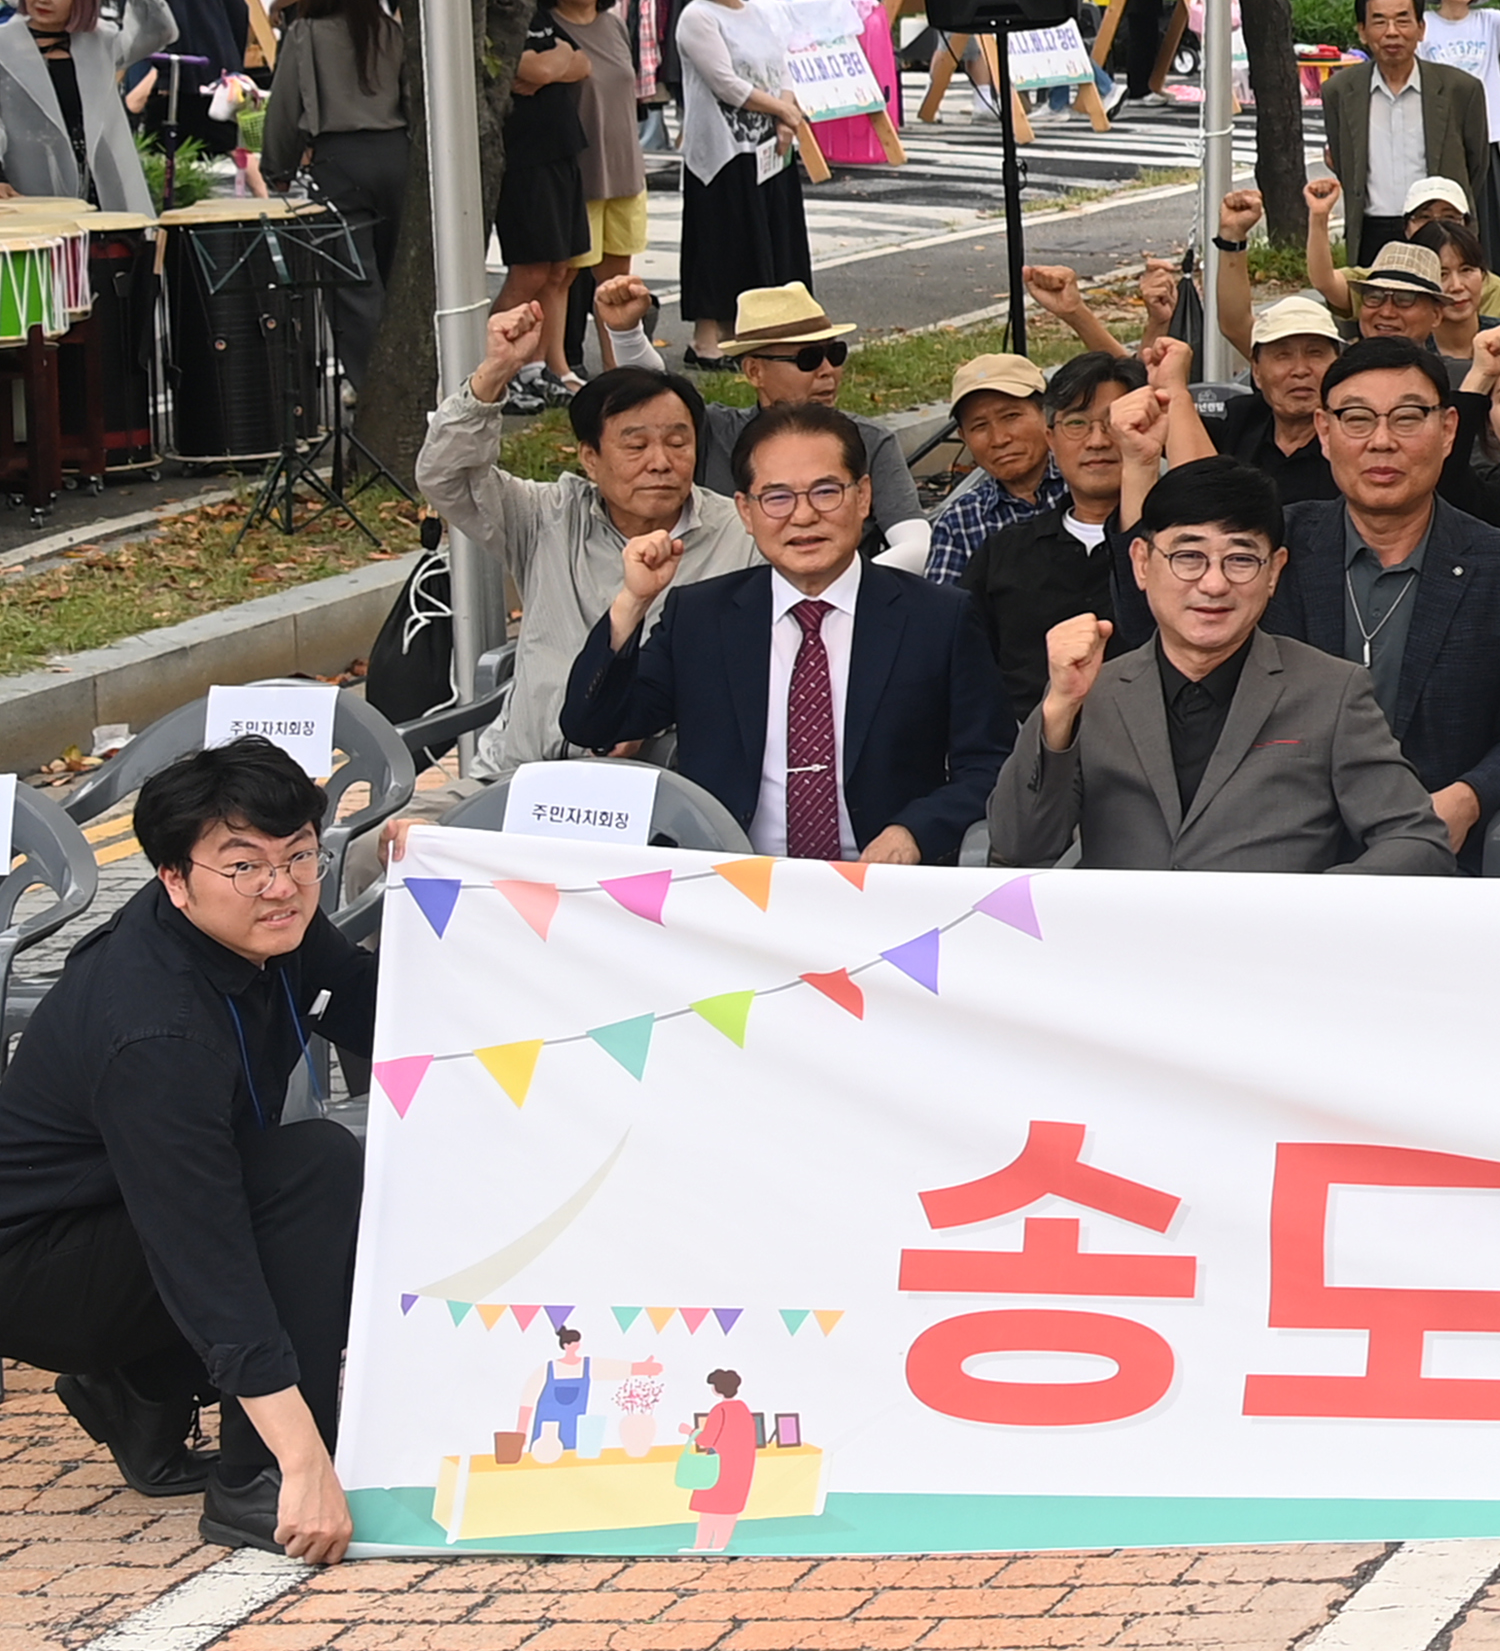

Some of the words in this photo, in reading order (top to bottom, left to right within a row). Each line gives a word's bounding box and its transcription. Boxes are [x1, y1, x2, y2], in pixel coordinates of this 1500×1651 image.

[841, 51, 867, 78] 장터
[229, 719, 317, 742] 주민자치회장
[530, 803, 630, 832] 주민자치회장
